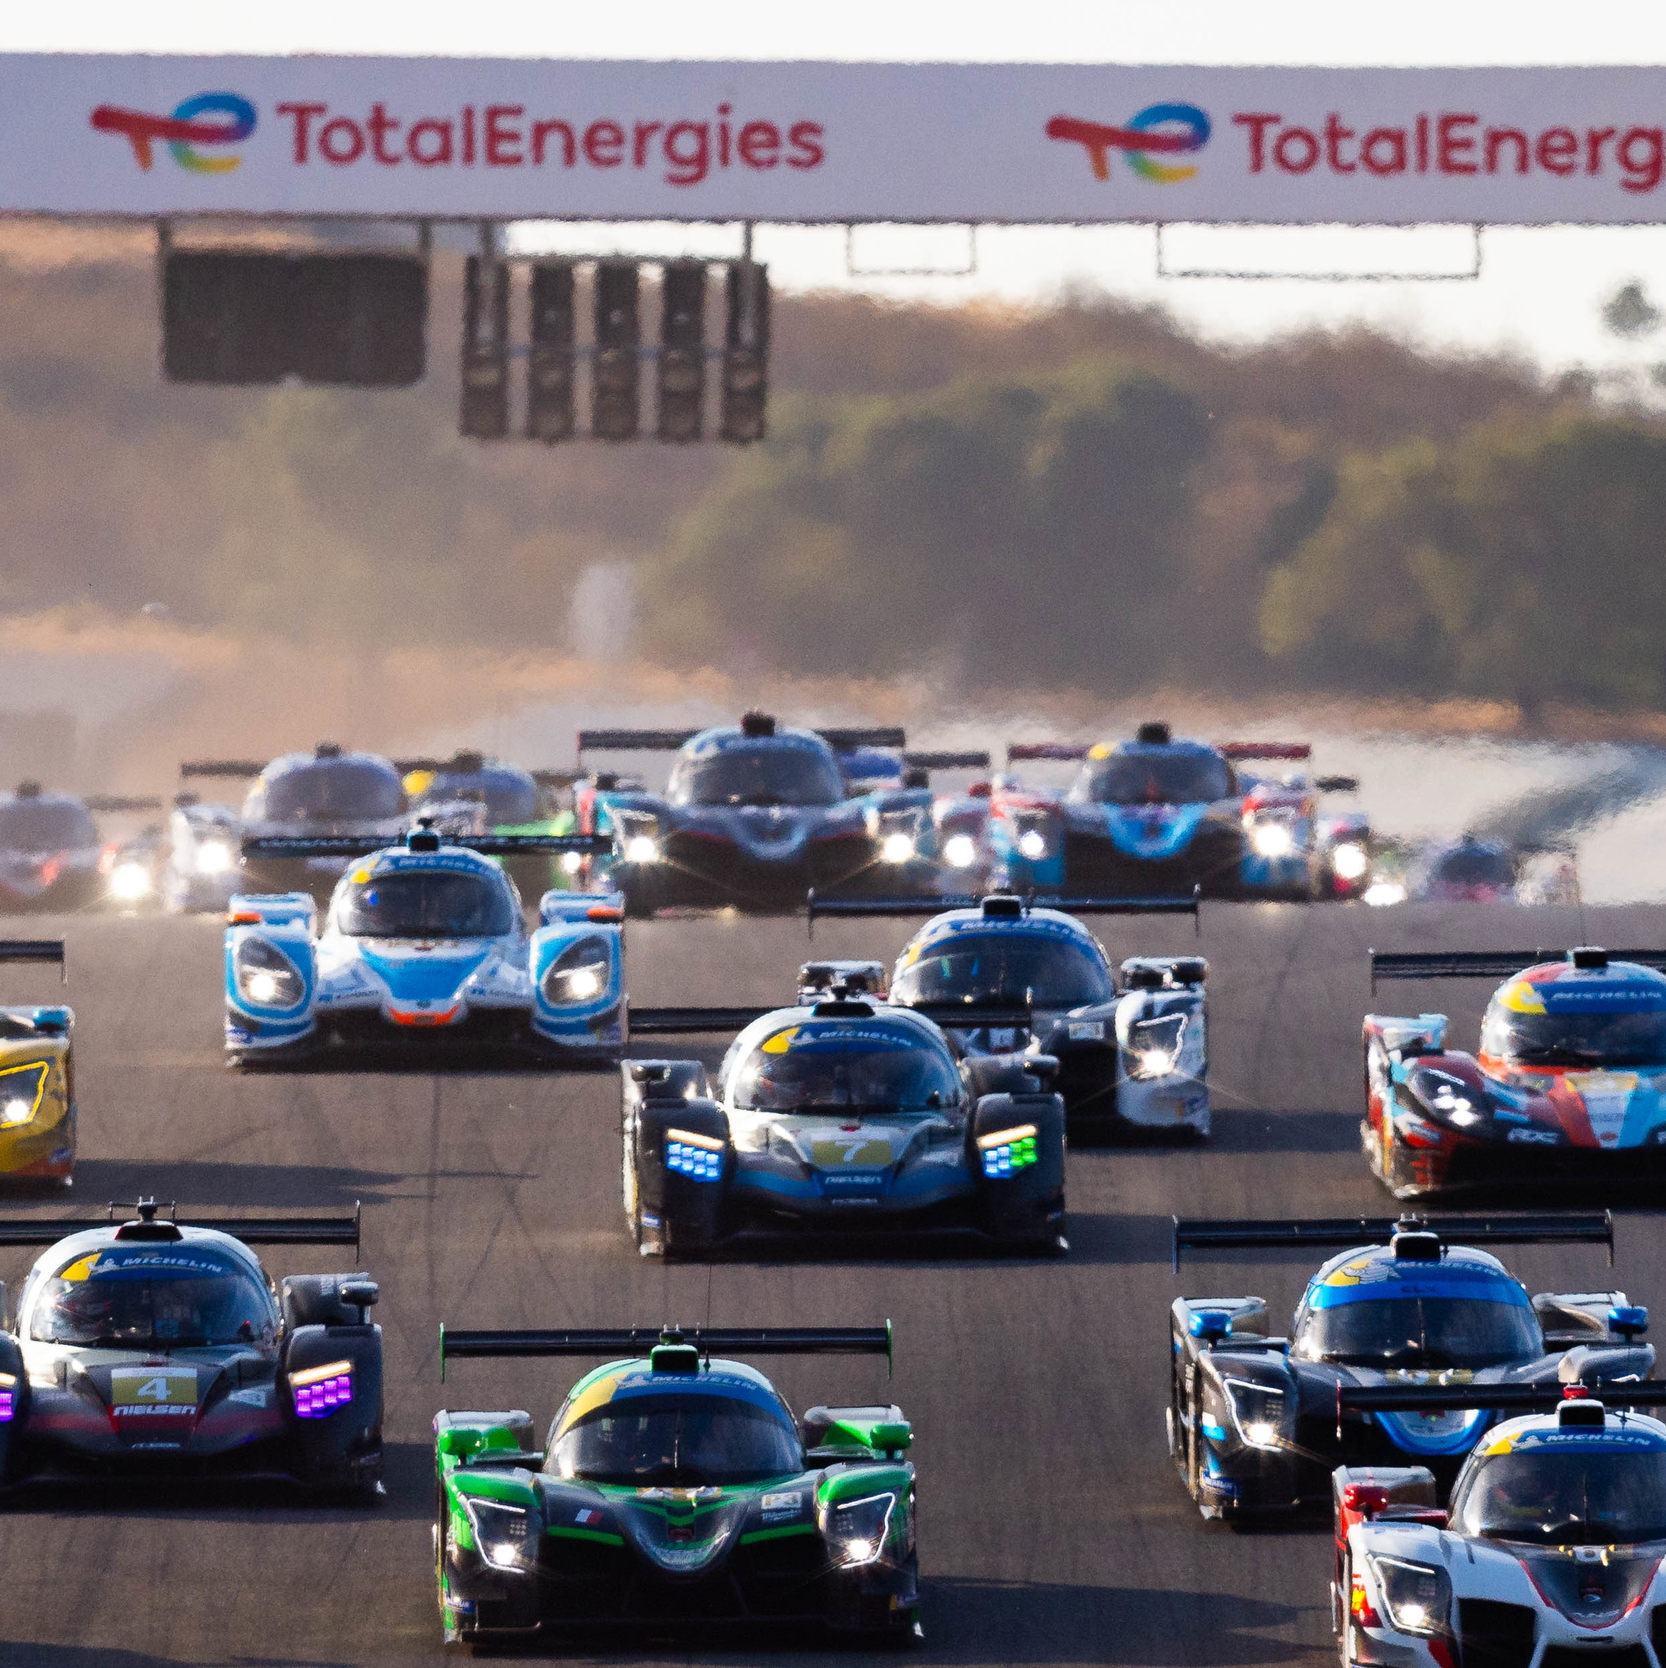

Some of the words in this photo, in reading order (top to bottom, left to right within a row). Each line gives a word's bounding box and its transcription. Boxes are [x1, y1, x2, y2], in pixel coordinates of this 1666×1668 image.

[277, 104, 825, 187] TotalEnergies
[819, 1031, 912, 1047] MICHELIN
[835, 1140, 870, 1162] 7
[122, 1257, 222, 1273] MICHELIN
[137, 1377, 173, 1401] 4
[113, 1403, 197, 1416] NIELSEN
[1545, 1433, 1651, 1446] MICHELIN
